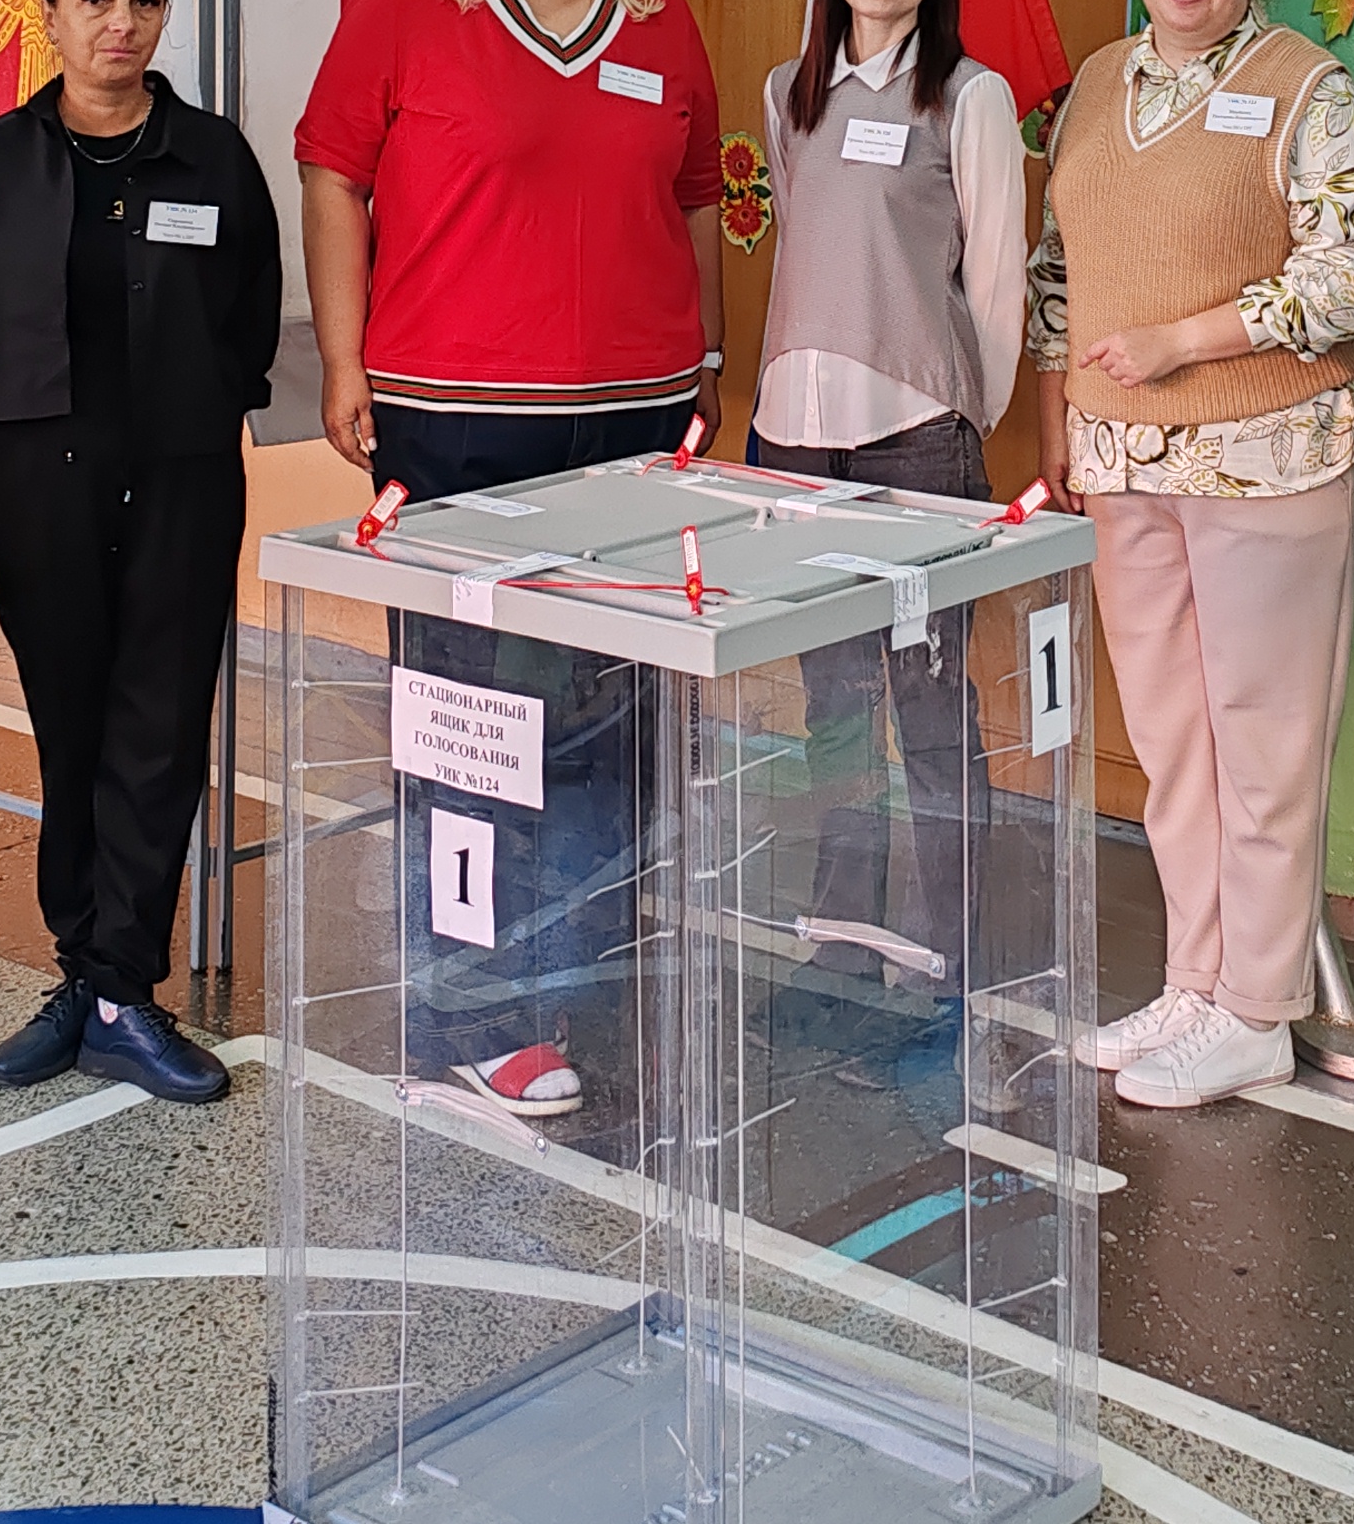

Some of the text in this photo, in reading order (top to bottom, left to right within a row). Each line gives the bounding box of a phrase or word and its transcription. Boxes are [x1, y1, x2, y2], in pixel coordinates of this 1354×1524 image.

[1038, 635, 1063, 715] 1
[408, 680, 527, 722] СТАЦИОНАРНЫЙ
[430, 710, 504, 741] ЯЩИК ДЛЯ
[414, 730, 520, 771] ГОЛОСОВАНИЯ
[434, 762, 461, 785] УИК
[452, 847, 475, 907] 1
